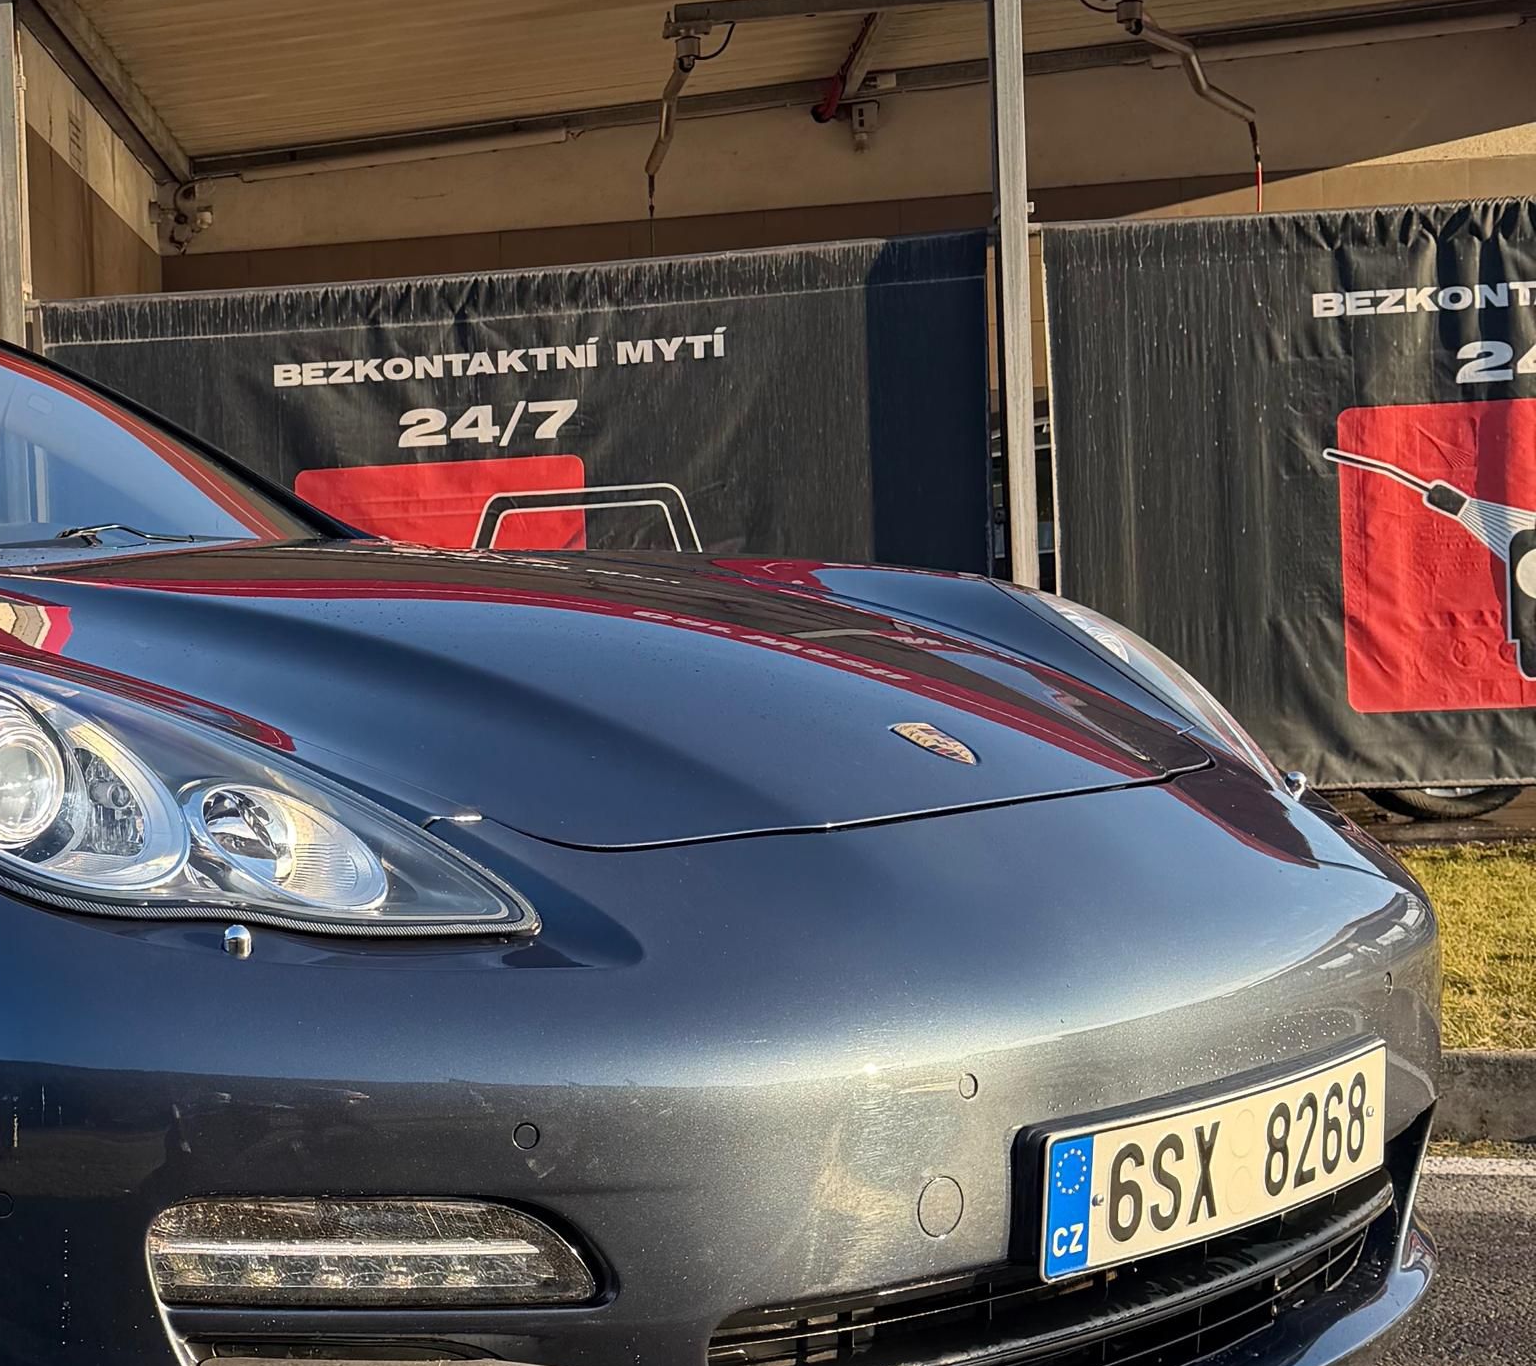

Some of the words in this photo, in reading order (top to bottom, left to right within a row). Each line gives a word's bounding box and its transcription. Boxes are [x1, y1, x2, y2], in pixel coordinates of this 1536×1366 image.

[1312, 280, 1536, 318] BEZKONT
[273, 337, 599, 388] BEZKONTAKTNÍ
[616, 326, 728, 366] MYTÍ
[398, 400, 578, 447] 24/7
[1108, 1121, 1220, 1242] 6SX
[1264, 1072, 1366, 1197] 8268
[1051, 1222, 1085, 1259] CZ
